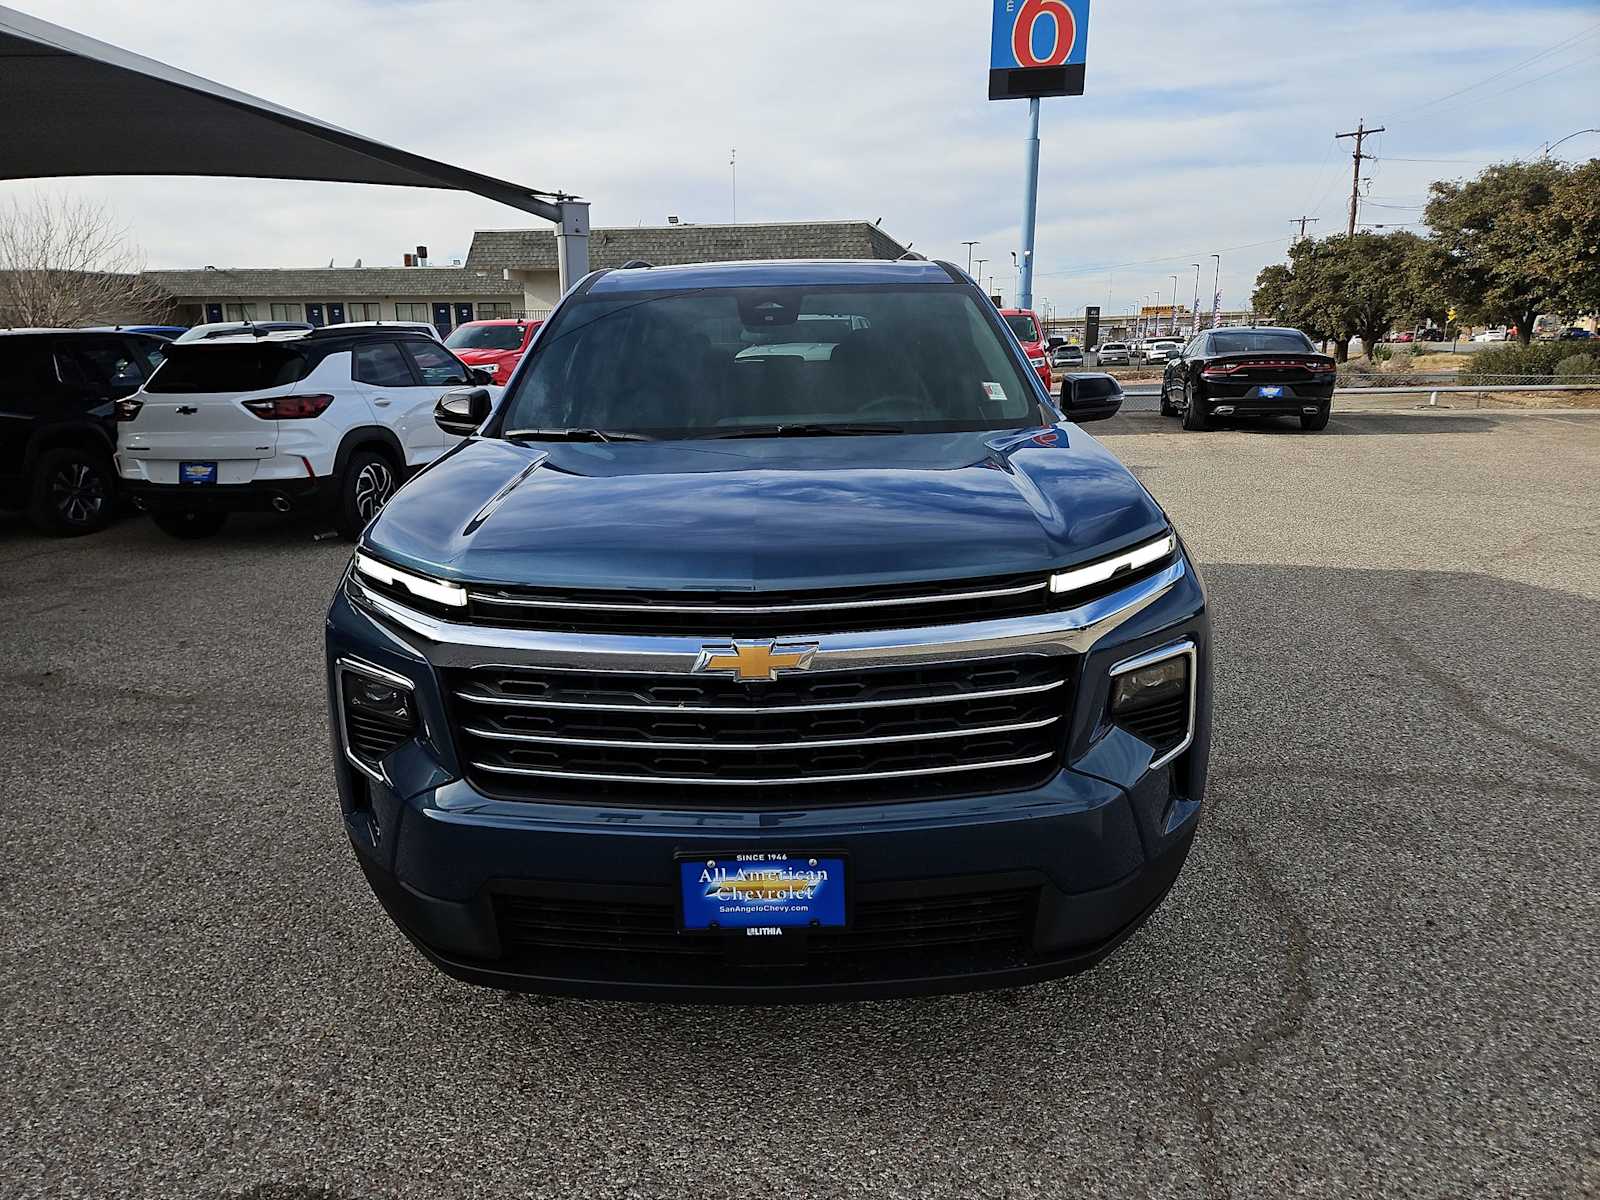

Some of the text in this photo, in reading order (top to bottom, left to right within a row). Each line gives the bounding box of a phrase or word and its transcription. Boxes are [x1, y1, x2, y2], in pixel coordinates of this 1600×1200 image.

[1011, 0, 1077, 68] 6
[767, 853, 788, 861] 1946
[699, 867, 828, 883] All American
[717, 885, 814, 902] Chevrolet
[719, 904, 809, 914] SanAngeloChevy.com
